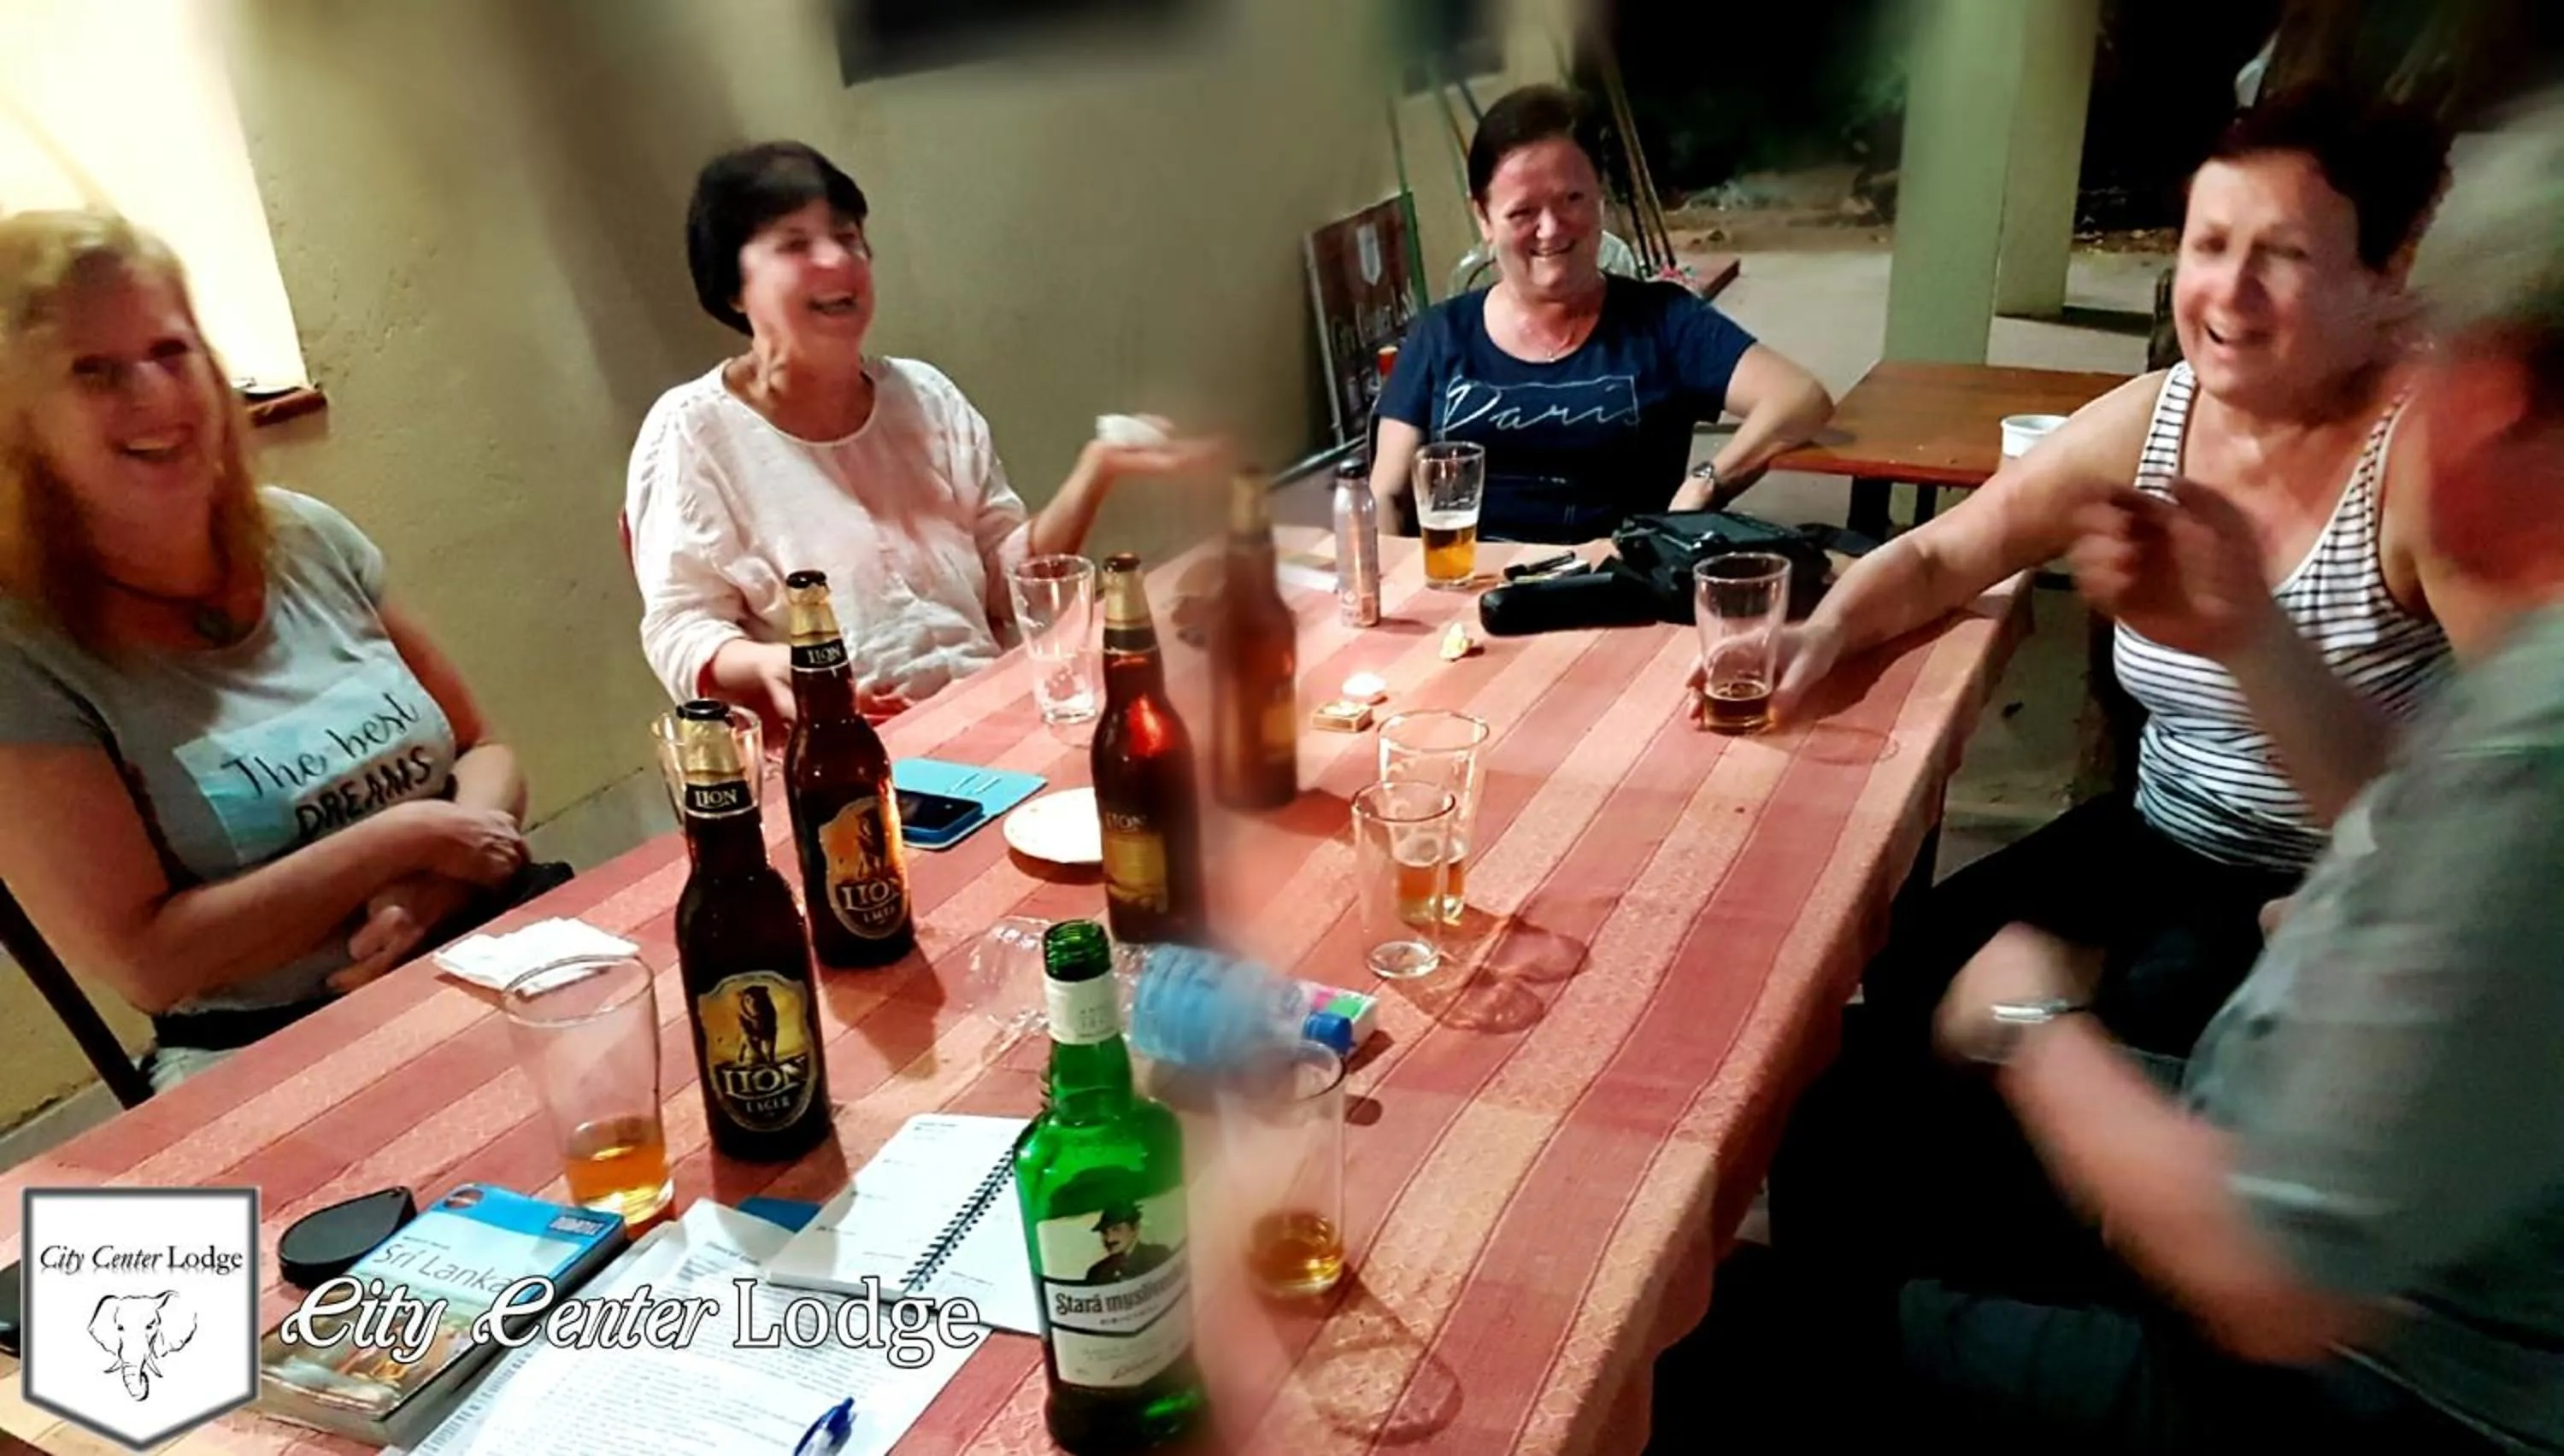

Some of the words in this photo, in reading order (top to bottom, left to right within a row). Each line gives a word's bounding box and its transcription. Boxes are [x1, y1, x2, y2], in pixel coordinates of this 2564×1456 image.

[221, 750, 327, 798] The
[326, 691, 423, 759] best
[294, 745, 433, 840] DREAMS
[695, 789, 737, 809] LION
[722, 1056, 807, 1100] LION
[373, 1244, 420, 1269] Sri
[418, 1253, 515, 1294] Lanka
[1055, 1292, 1103, 1316] Stará
